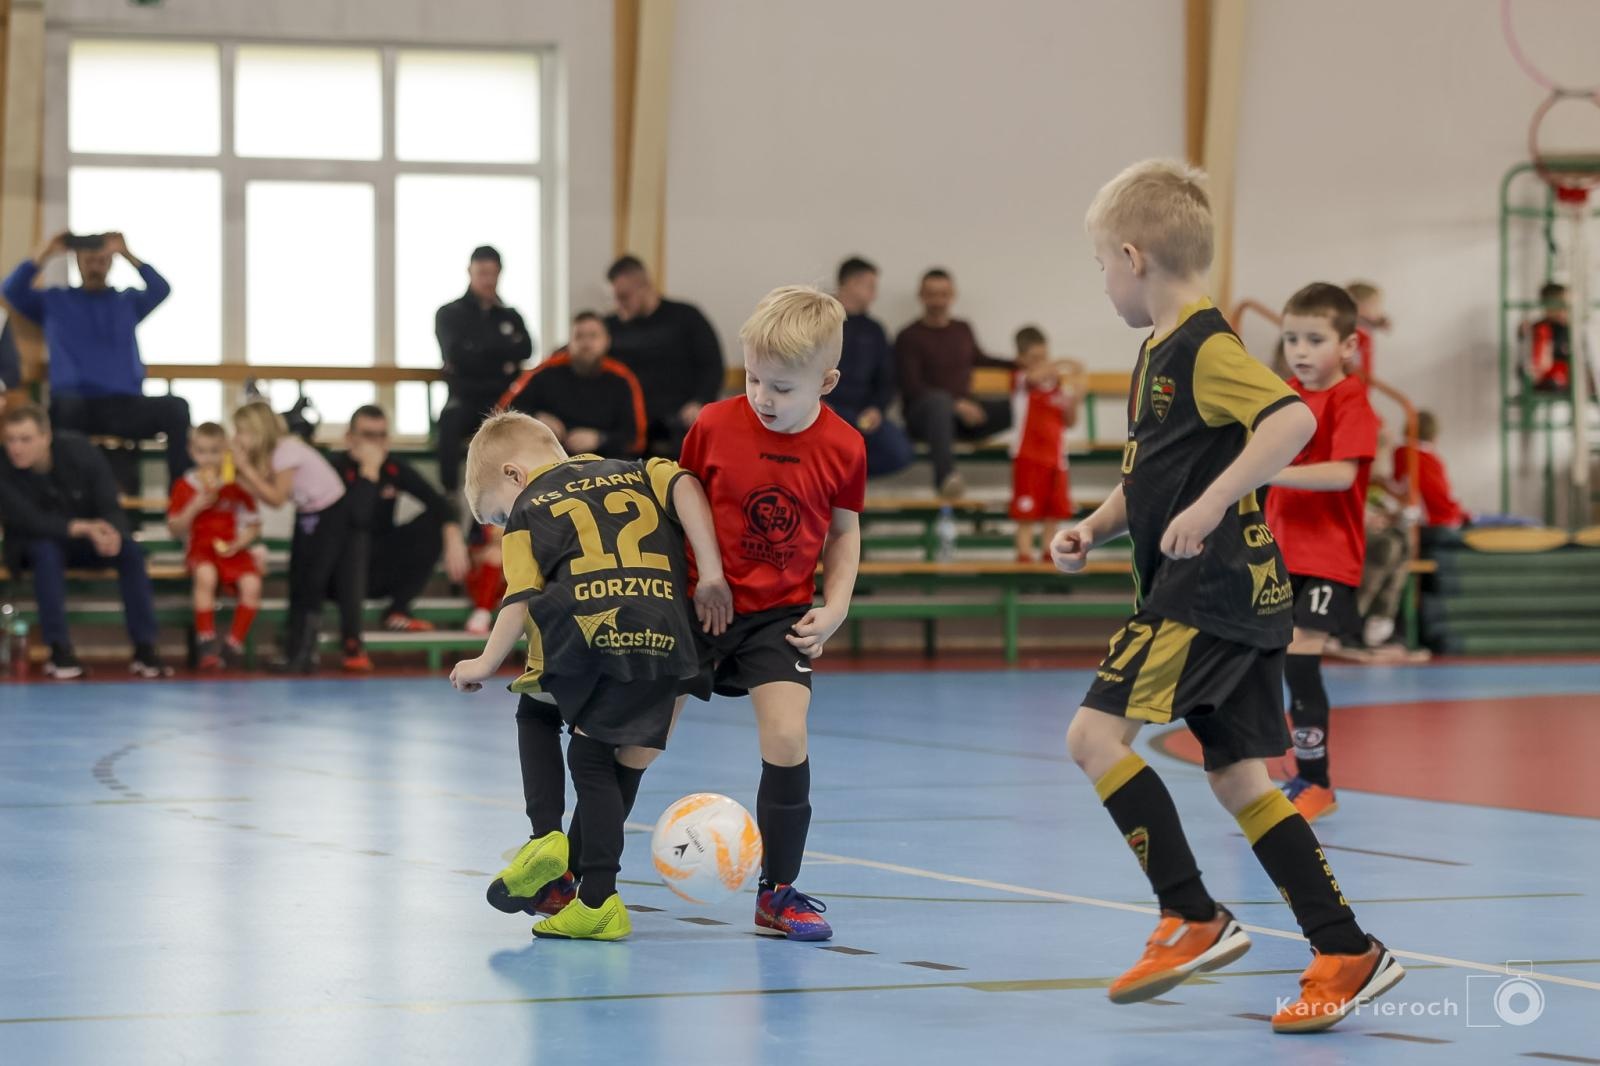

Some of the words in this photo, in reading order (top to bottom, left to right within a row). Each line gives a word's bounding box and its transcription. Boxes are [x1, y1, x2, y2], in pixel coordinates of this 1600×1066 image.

[531, 490, 563, 505] KS
[550, 488, 671, 575] 12
[574, 577, 674, 601] GORZYCE
